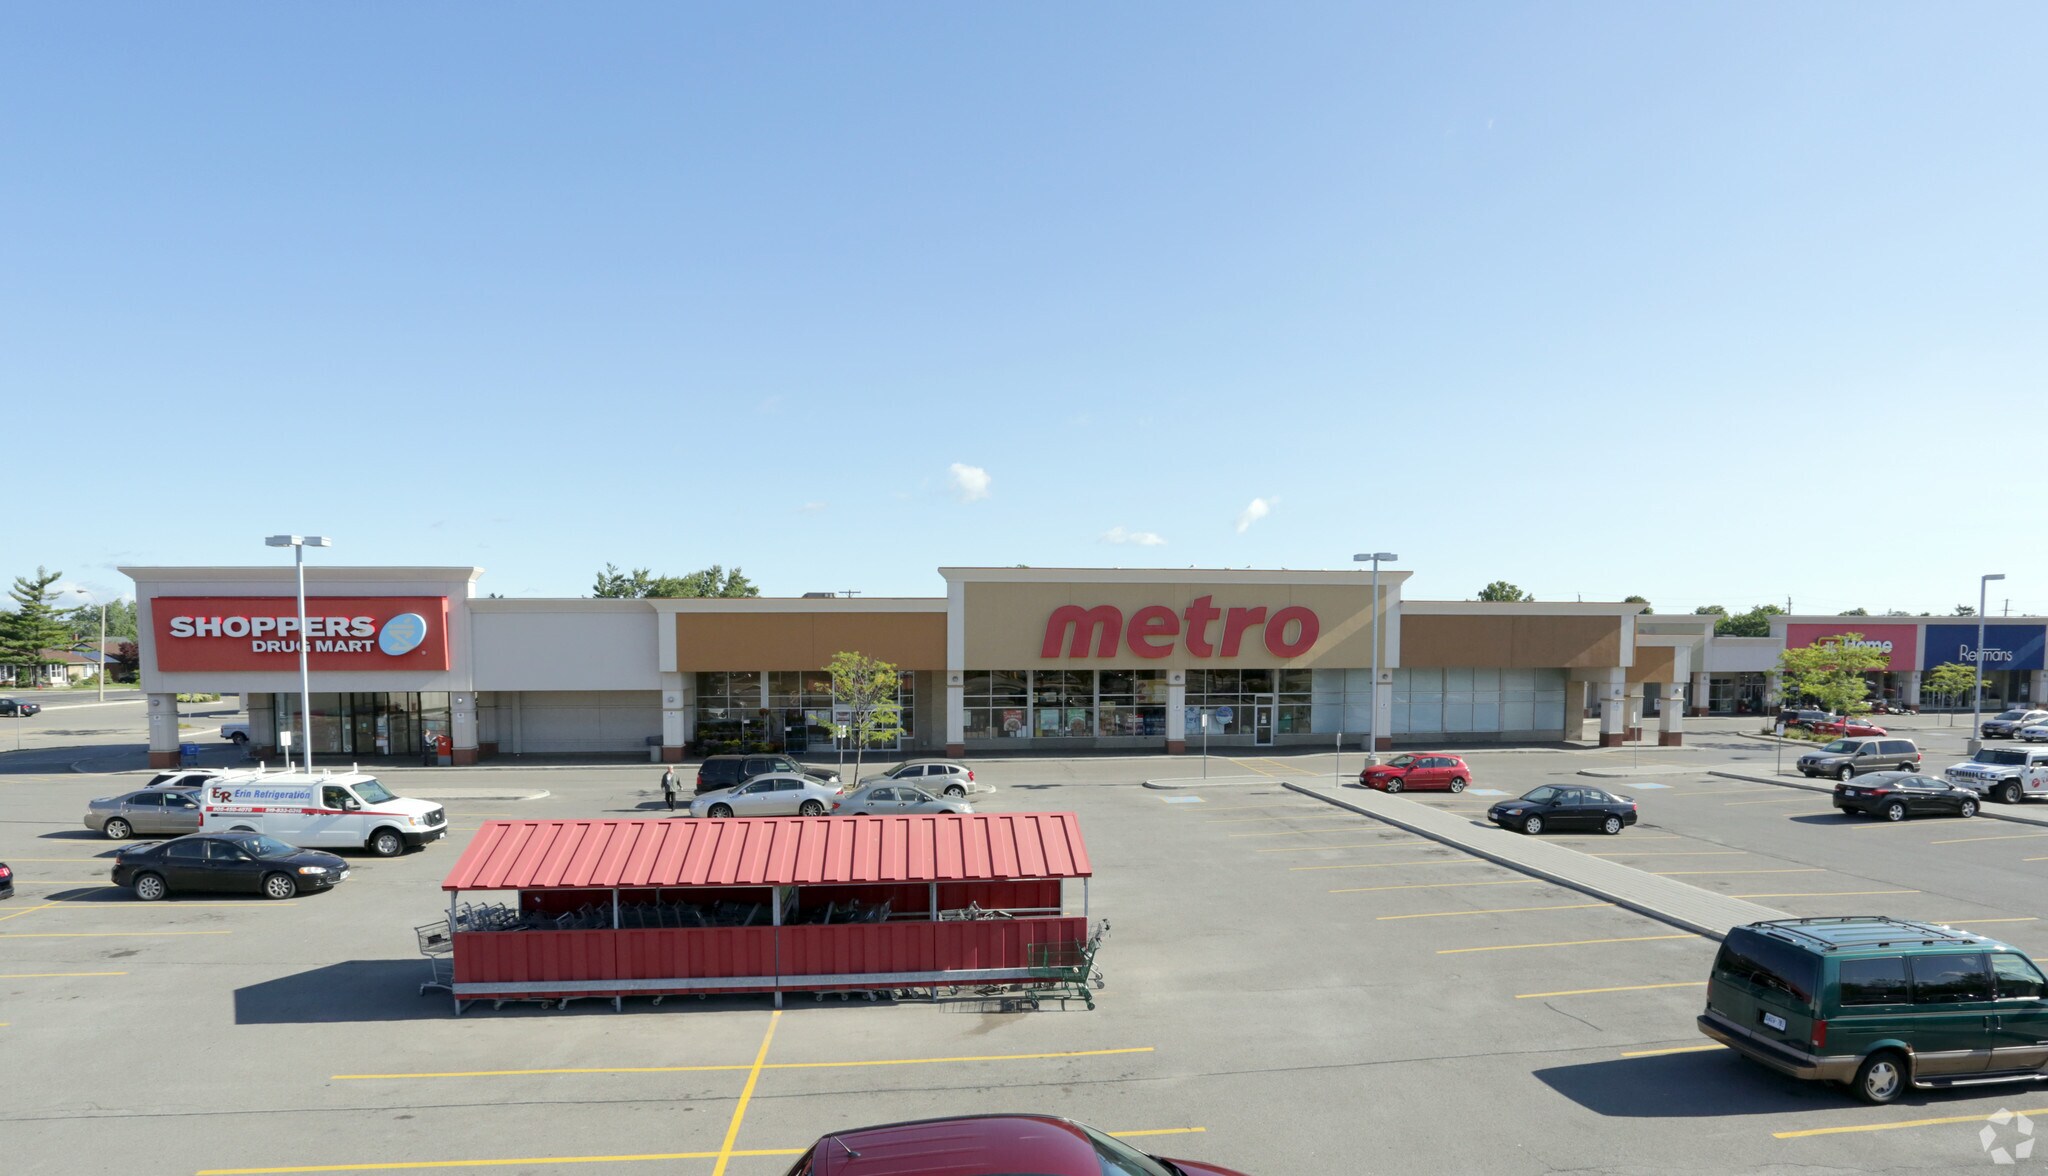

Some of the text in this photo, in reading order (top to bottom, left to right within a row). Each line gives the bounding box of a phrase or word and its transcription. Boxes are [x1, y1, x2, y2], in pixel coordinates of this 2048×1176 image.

[169, 615, 376, 638] SHOPPERS
[1040, 594, 1320, 659] metro
[252, 640, 374, 653] DRUG MART
[1959, 644, 2013, 662] Reimans
[234, 789, 310, 800] Erin Refrigeration
